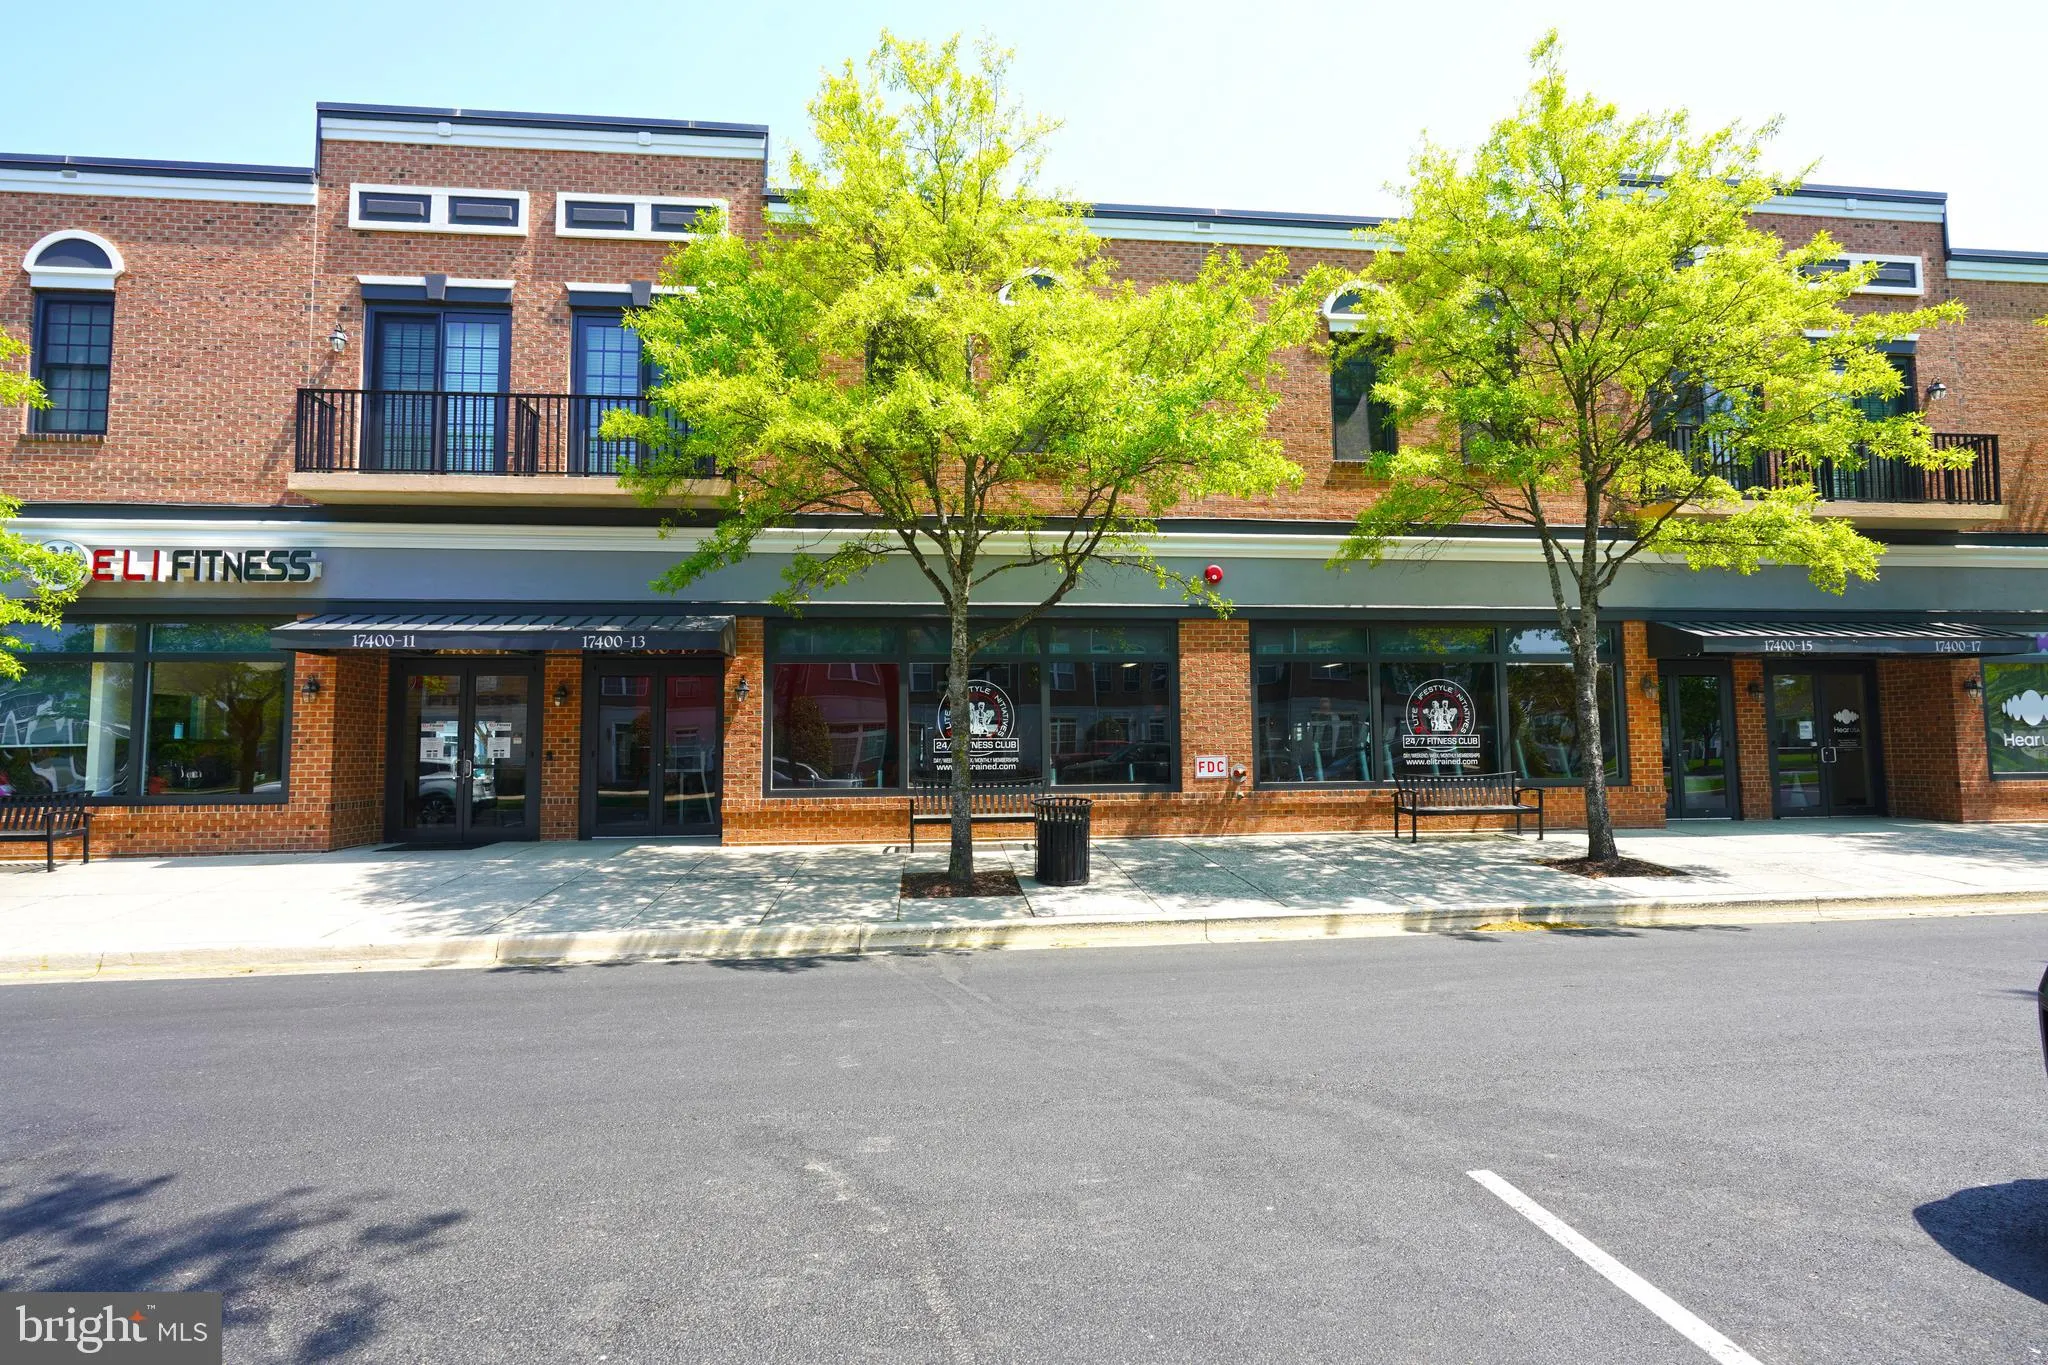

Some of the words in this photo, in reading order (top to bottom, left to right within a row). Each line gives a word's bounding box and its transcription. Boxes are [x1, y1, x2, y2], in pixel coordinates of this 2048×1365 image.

[92, 550, 160, 581] ELI
[171, 550, 313, 582] FITNESS
[352, 634, 416, 648] 17400-11
[582, 635, 646, 649] 17400-13
[1764, 640, 1813, 651] 17400-15
[1935, 641, 1981, 652] 17400-17
[936, 741, 952, 750] 24/
[971, 741, 993, 749] NESS
[1405, 737, 1425, 746] 24/7
[1427, 737, 1457, 745] FITNESS
[1458, 737, 1478, 745] CLUB
[1198, 761, 1224, 773] FDC
